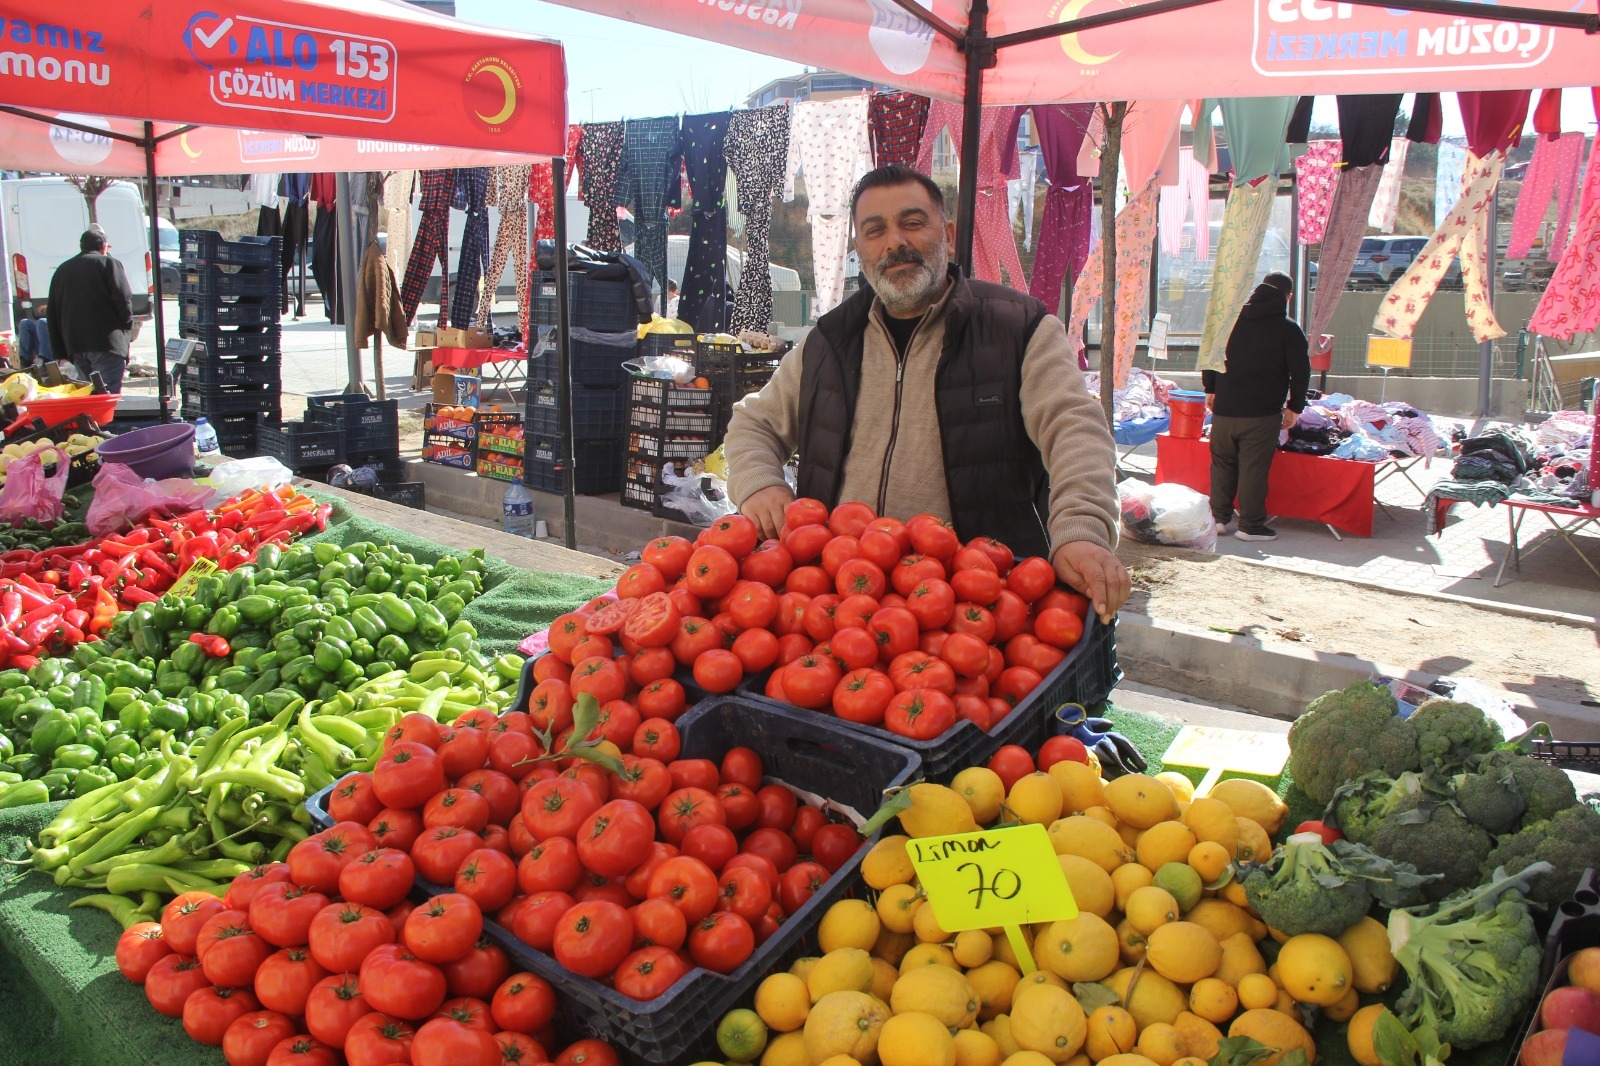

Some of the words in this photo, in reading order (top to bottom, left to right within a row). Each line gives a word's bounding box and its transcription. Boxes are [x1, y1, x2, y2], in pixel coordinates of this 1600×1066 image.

[245, 25, 319, 72] ALO
[328, 38, 390, 82] 153
[218, 66, 296, 102] ÇÖZÜM
[300, 80, 387, 112] MERKEZİ
[915, 837, 1001, 863] Limon
[956, 862, 1022, 910] 70
